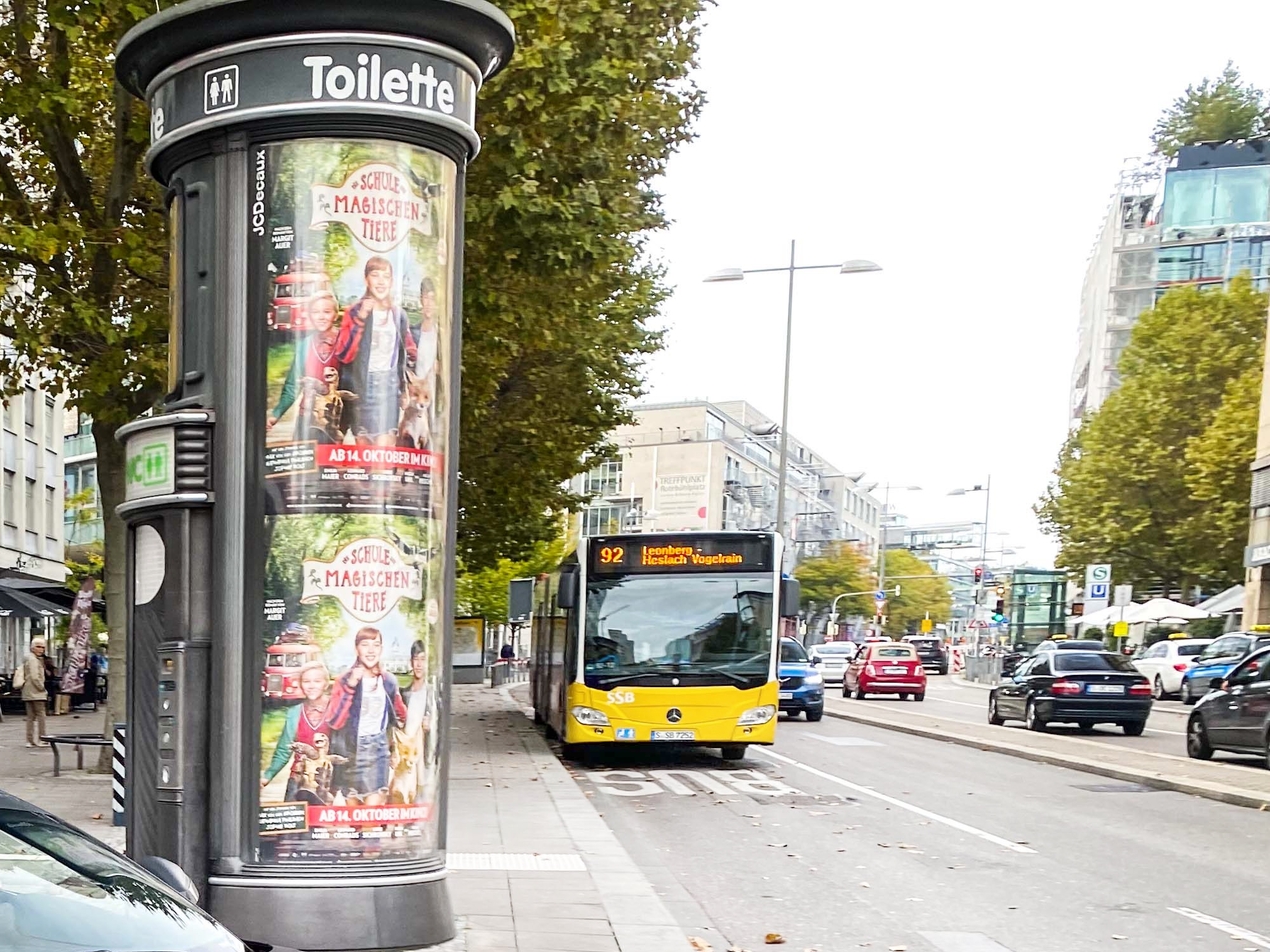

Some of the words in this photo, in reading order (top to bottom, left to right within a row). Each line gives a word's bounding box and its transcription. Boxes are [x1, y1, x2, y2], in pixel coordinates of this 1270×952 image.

[303, 53, 455, 114] Toilette
[360, 171, 400, 194] SCHULE
[252, 149, 266, 236] JCDecaux
[329, 449, 345, 461] AB
[347, 451, 359, 462] 14.
[363, 450, 409, 464] OKTOBER
[351, 545, 390, 565] SCHULE
[600, 547, 624, 563] 92
[642, 545, 693, 556] Leonberg
[607, 690, 635, 705] SSB
[319, 810, 336, 822] AB
[337, 810, 352, 822] 14.
[353, 808, 400, 822] OKTOBER
